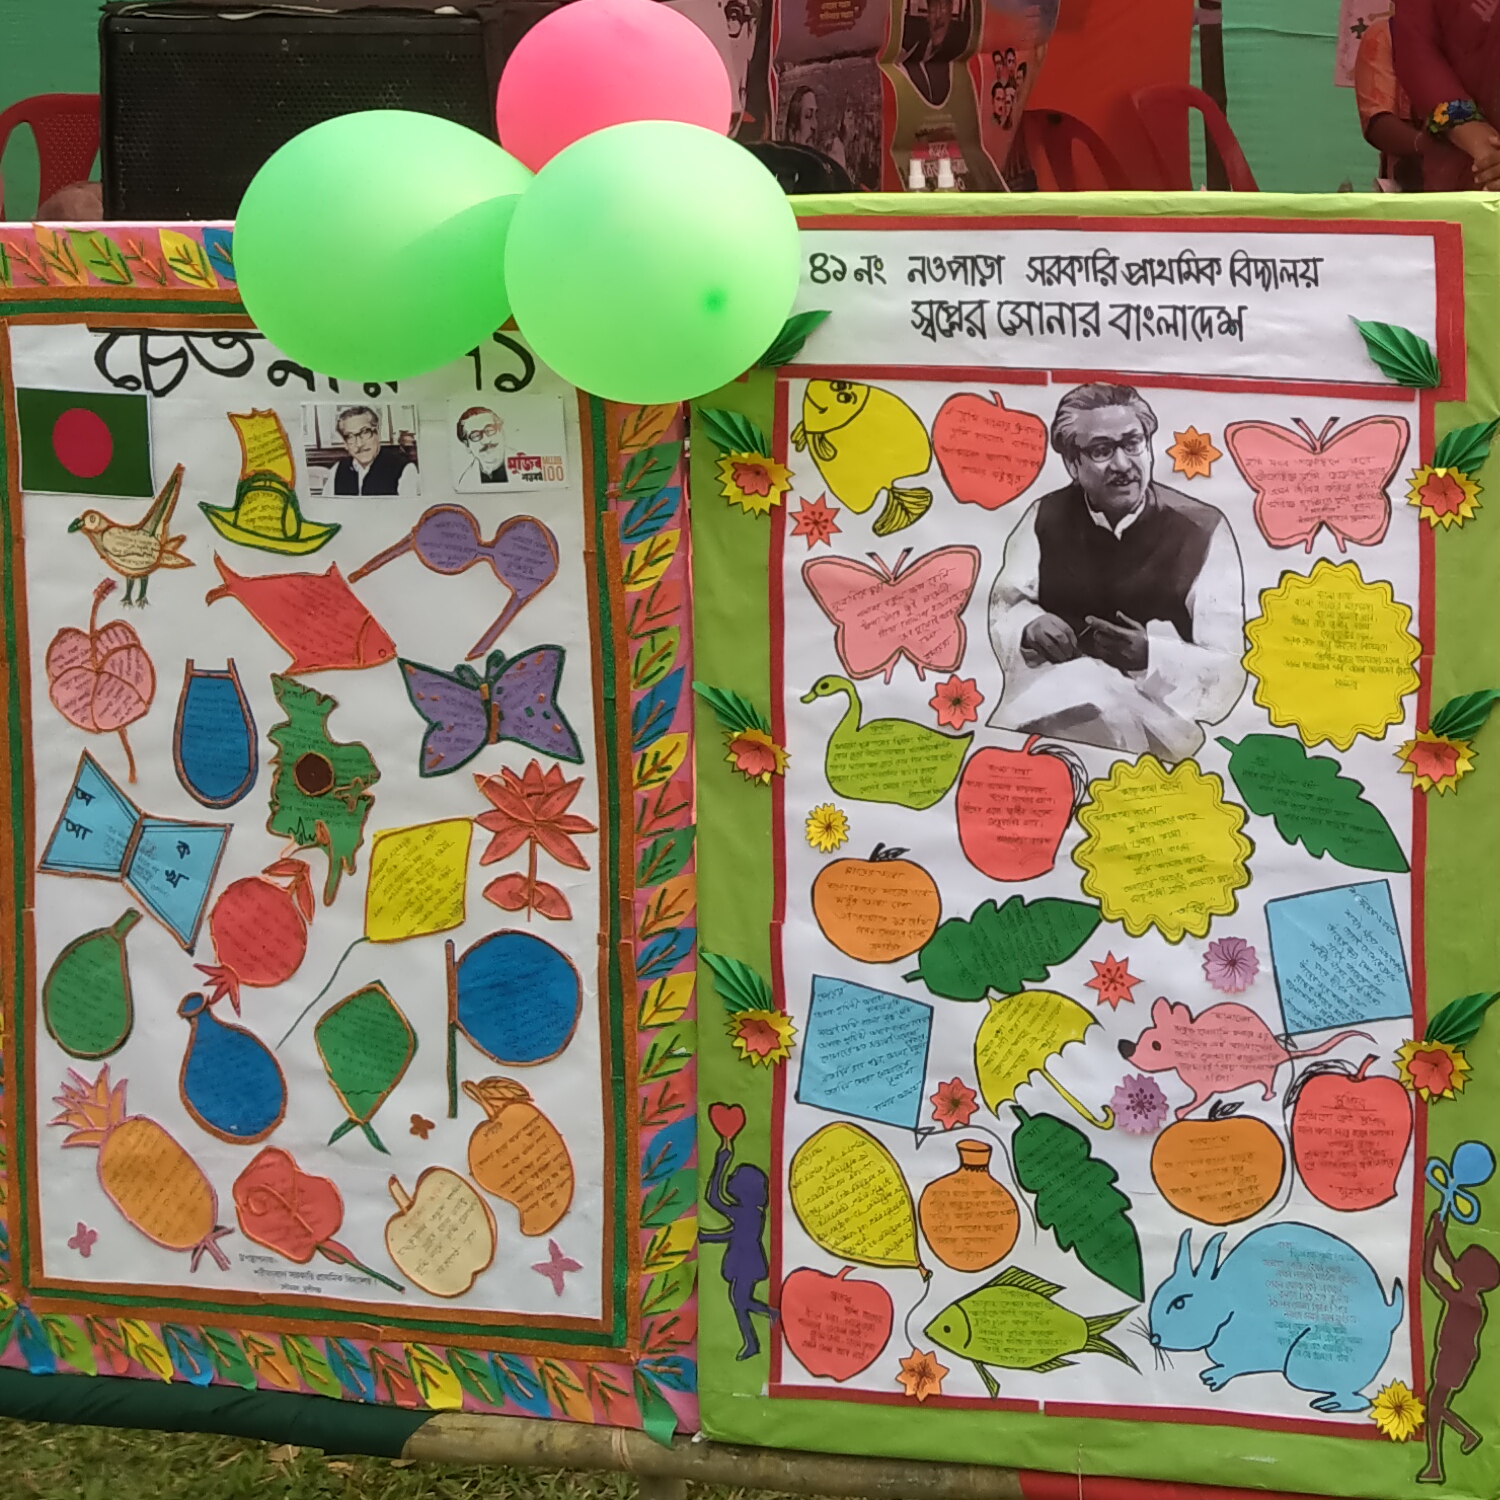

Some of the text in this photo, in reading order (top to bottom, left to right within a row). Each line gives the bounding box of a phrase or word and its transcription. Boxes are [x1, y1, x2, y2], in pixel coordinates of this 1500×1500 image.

[853, 254, 888, 287] নং
[1025, 248, 1121, 288] সরকারি
[1121, 249, 1224, 287] প্রাথমিক
[1229, 249, 1324, 293] বিদ্যালয়
[996, 298, 1102, 340] সোনার
[1108, 301, 1249, 343] বাংলাদেশ
